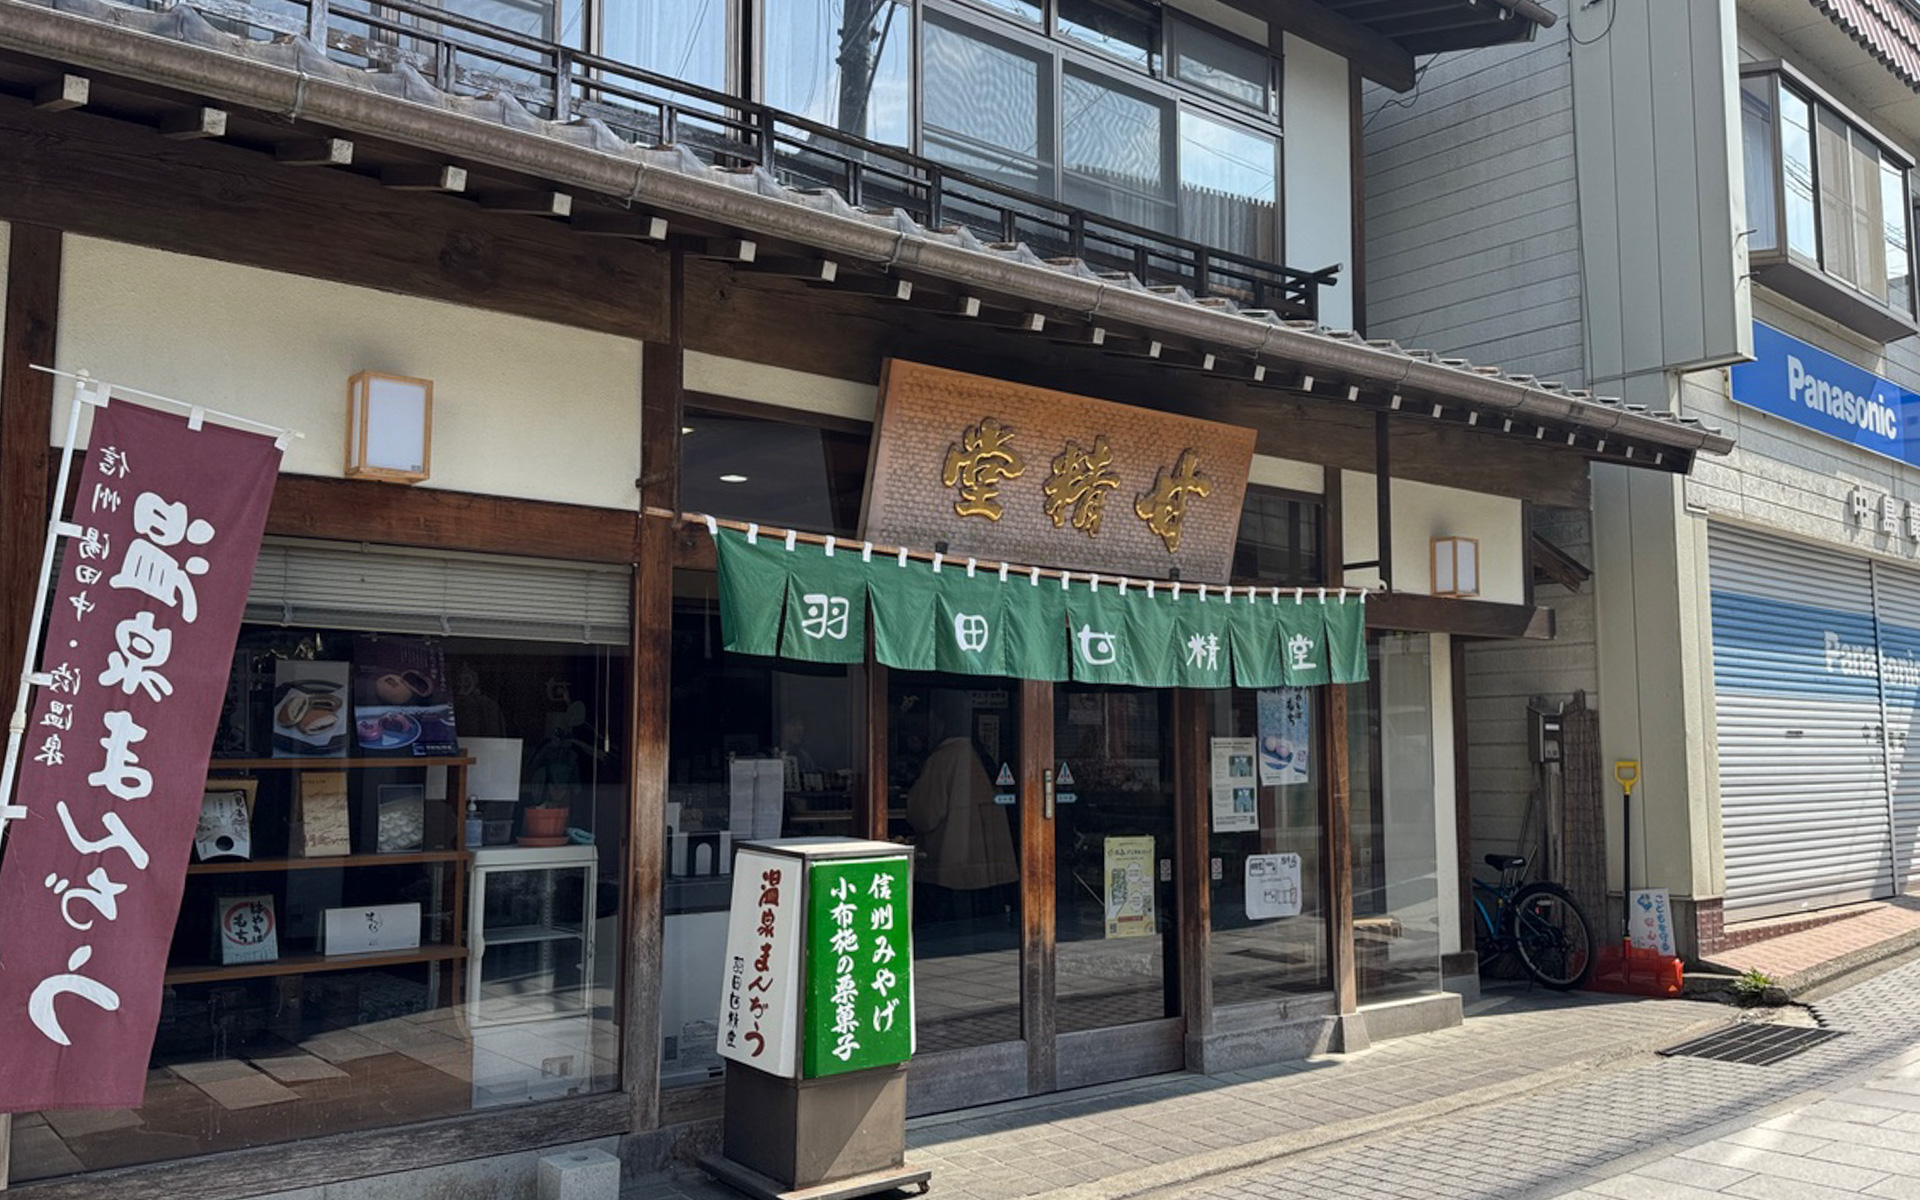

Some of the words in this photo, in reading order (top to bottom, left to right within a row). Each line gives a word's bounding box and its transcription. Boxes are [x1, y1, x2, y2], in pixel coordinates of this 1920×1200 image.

[1787, 354, 1898, 440] Panasonic
[944, 417, 1211, 553] 甘精堂
[744, 868, 781, 1058] 温泉まんぢう
[829, 876, 861, 1061] 小布施の栗菓子
[867, 872, 900, 1032] 信州みやげ
